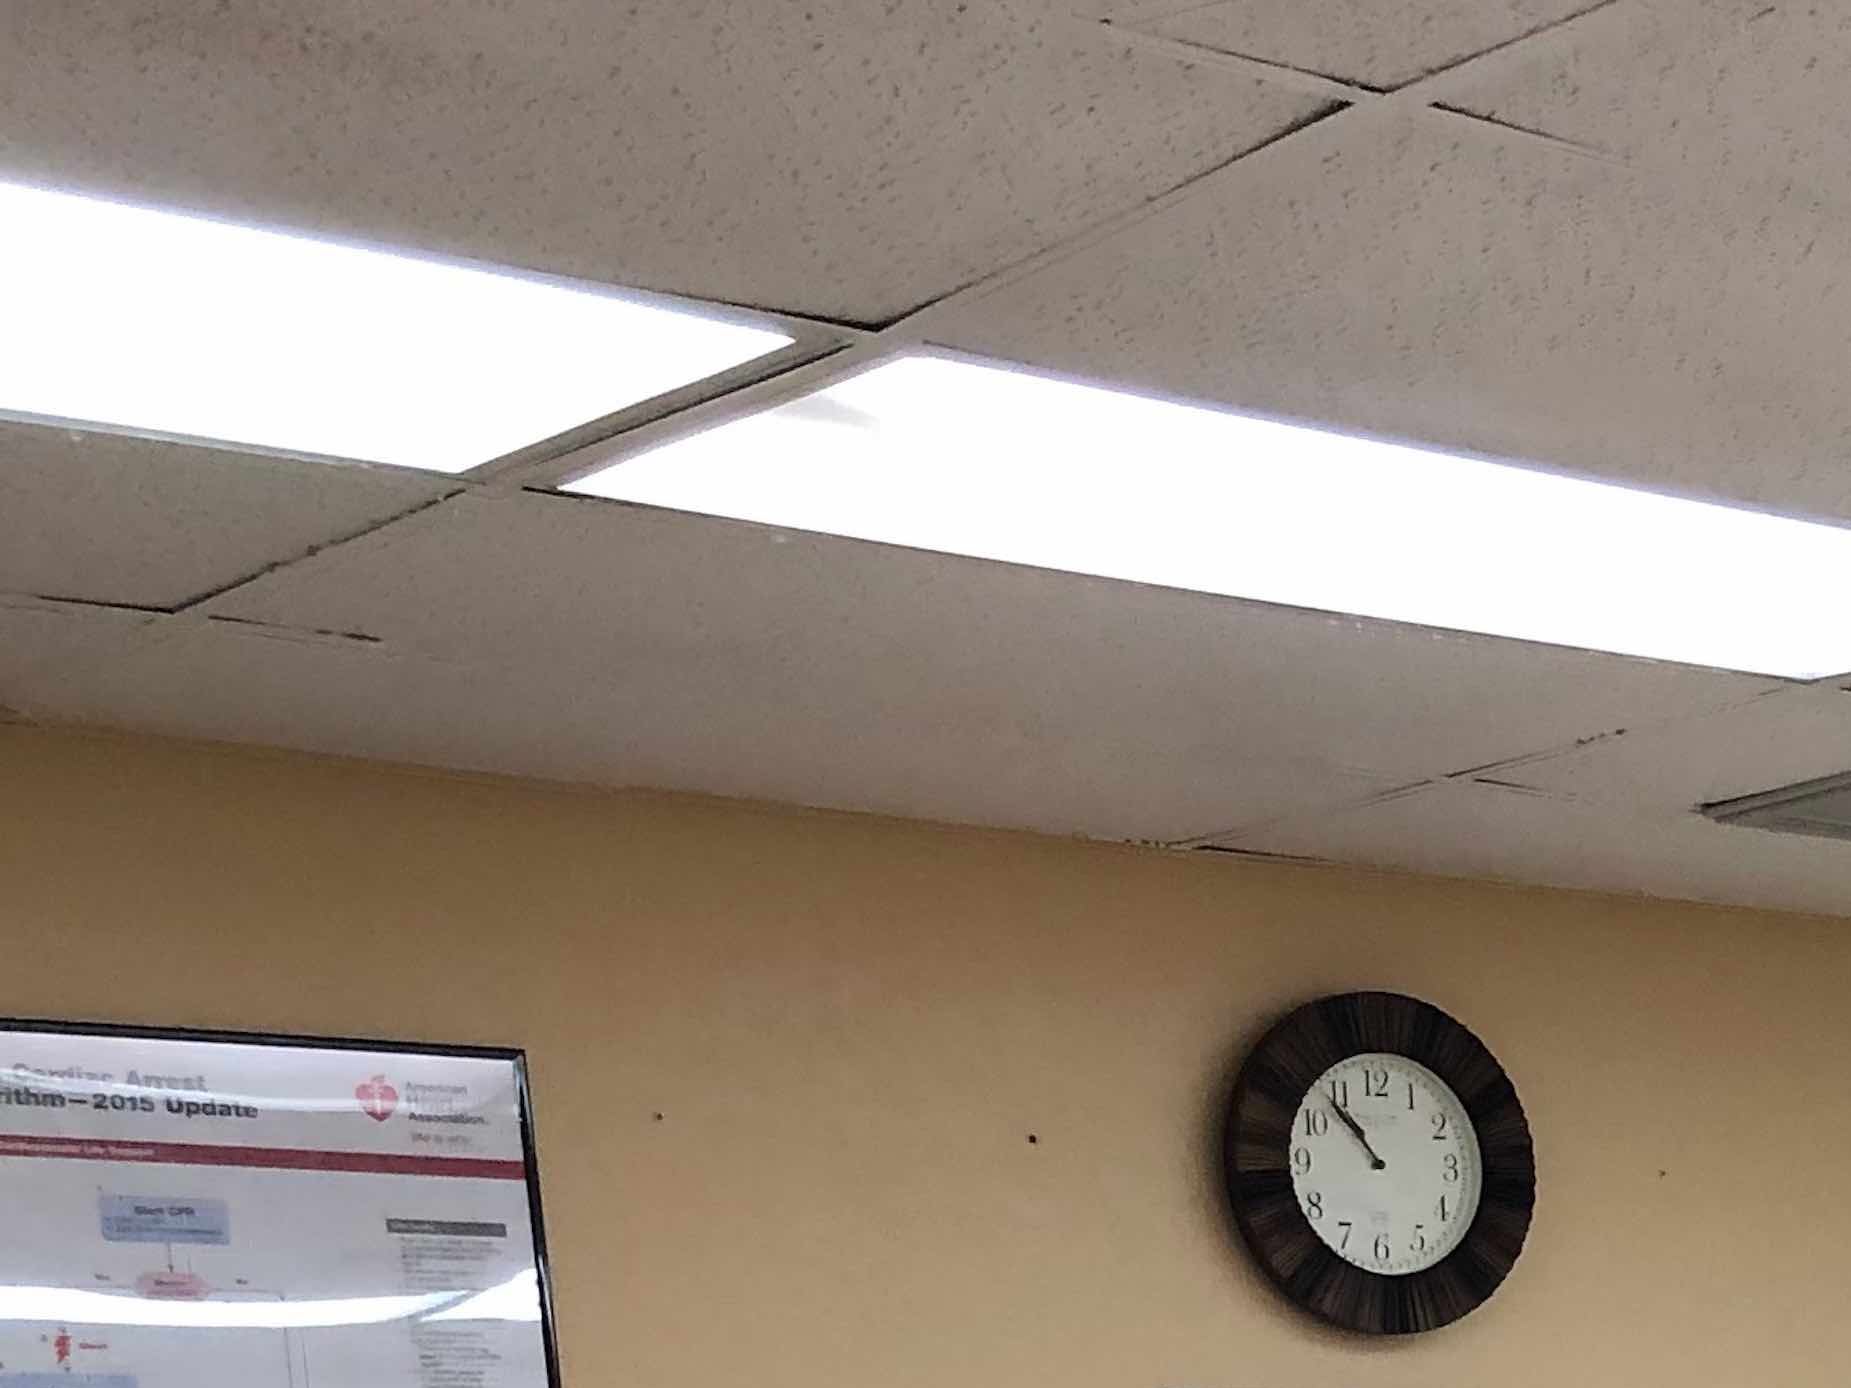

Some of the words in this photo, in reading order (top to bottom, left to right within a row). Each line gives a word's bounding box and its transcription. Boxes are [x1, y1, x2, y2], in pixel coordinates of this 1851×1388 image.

[1331, 1080, 1347, 1108] 11
[1365, 1069, 1389, 1096] 12
[1408, 1083, 1414, 1110] 1
[165, 1099, 259, 1119] Update
[1305, 1108, 1328, 1136] 10
[1432, 1112, 1446, 1140] 2
[1294, 1148, 1311, 1176] 9
[1443, 1154, 1458, 1182] 3
[1307, 1191, 1323, 1220] 8
[1338, 1221, 1352, 1249] 7
[1374, 1233, 1389, 1261] 6
[1410, 1225, 1424, 1251] 5
